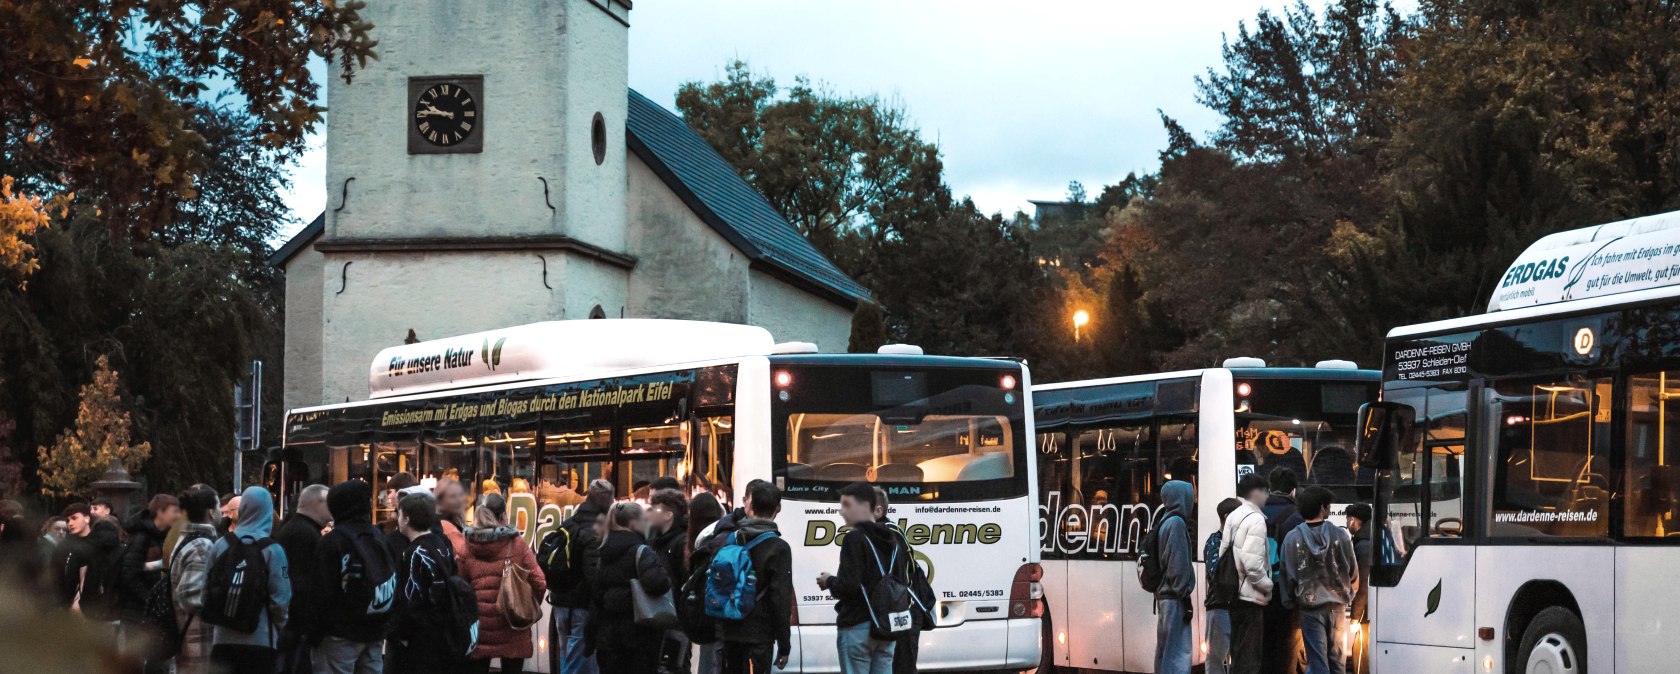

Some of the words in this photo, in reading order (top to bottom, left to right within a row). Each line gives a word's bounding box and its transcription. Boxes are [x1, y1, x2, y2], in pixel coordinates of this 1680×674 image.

[1591, 253, 1604, 266] Ich
[1601, 251, 1623, 268] fahre
[1623, 248, 1638, 261] mit
[1637, 245, 1663, 261] Erdgas
[1663, 243, 1674, 254] im
[1502, 255, 1570, 289] ERDGAS
[1586, 276, 1600, 292] gut
[1599, 274, 1613, 290] für
[1611, 272, 1623, 285] die
[1654, 265, 1669, 282] gut
[388, 356, 405, 378] Für
[406, 353, 441, 375] unsere
[443, 347, 474, 369] Natur
[382, 408, 434, 427] Emissionsarm
[434, 404, 449, 421] mit
[449, 402, 478, 422] Erdgas
[480, 400, 498, 417] und
[498, 398, 528, 418] Biogas
[529, 393, 557, 413] durch
[558, 391, 578, 410] den
[579, 384, 646, 408] Nationalpark
[646, 380, 674, 402] Eifel
[812, 485, 830, 493] City
[888, 486, 921, 495] MAN
[915, 505, 1001, 514] info@dardenne-reisen.de
[1495, 508, 1598, 523] www.dardenne-reisen.de
[959, 589, 1004, 598] 02445/5383
